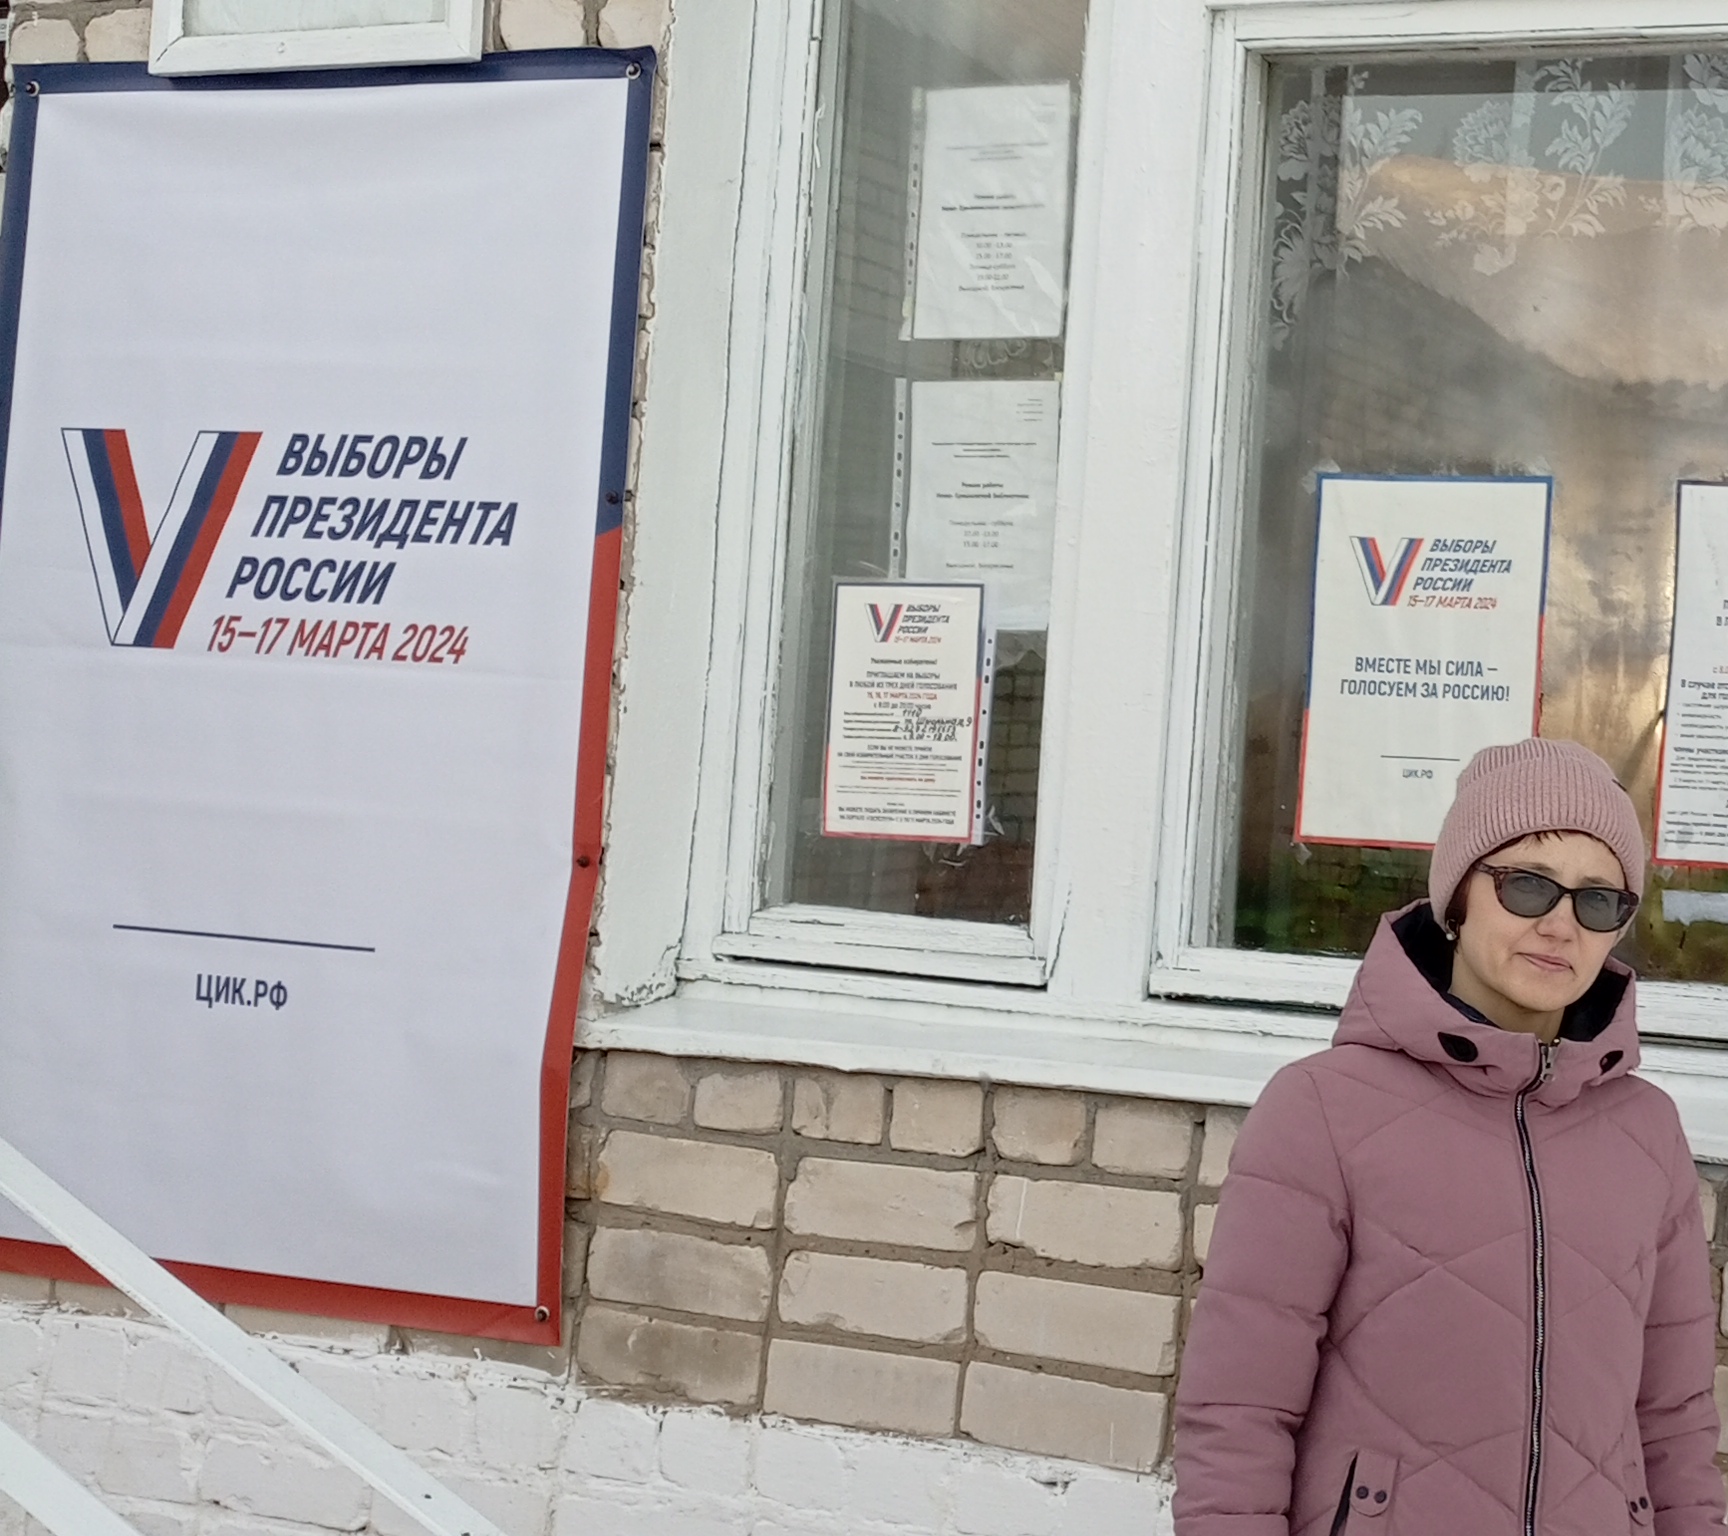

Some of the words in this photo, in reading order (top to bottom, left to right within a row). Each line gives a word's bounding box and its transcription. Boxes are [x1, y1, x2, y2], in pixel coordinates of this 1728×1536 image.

[276, 433, 468, 481] ВЫБОРЫ
[250, 495, 519, 550] ПРЕЗИДЕНТА
[1429, 538, 1498, 554] ВЫБОРЫ
[1420, 557, 1513, 575] ПРЕЗИДЕНТА
[225, 556, 397, 606] РОССИИ
[1412, 576, 1474, 592] РОССИИ
[1436, 595, 1472, 610] МАРТА
[1473, 597, 1498, 610] 2024
[287, 619, 393, 662] МАРТА
[392, 623, 469, 664] 2024
[1354, 656, 1412, 674] ВМЕСТЕ
[1415, 659, 1441, 675] МЫ
[1445, 660, 1484, 677] СИЛА
[1339, 678, 1417, 697] ГОЛОСУЕМ
[1420, 682, 1438, 699] ЗА
[1442, 683, 1510, 702] РОССИЮ!
[195, 973, 288, 1011] ЦИК.РФ
